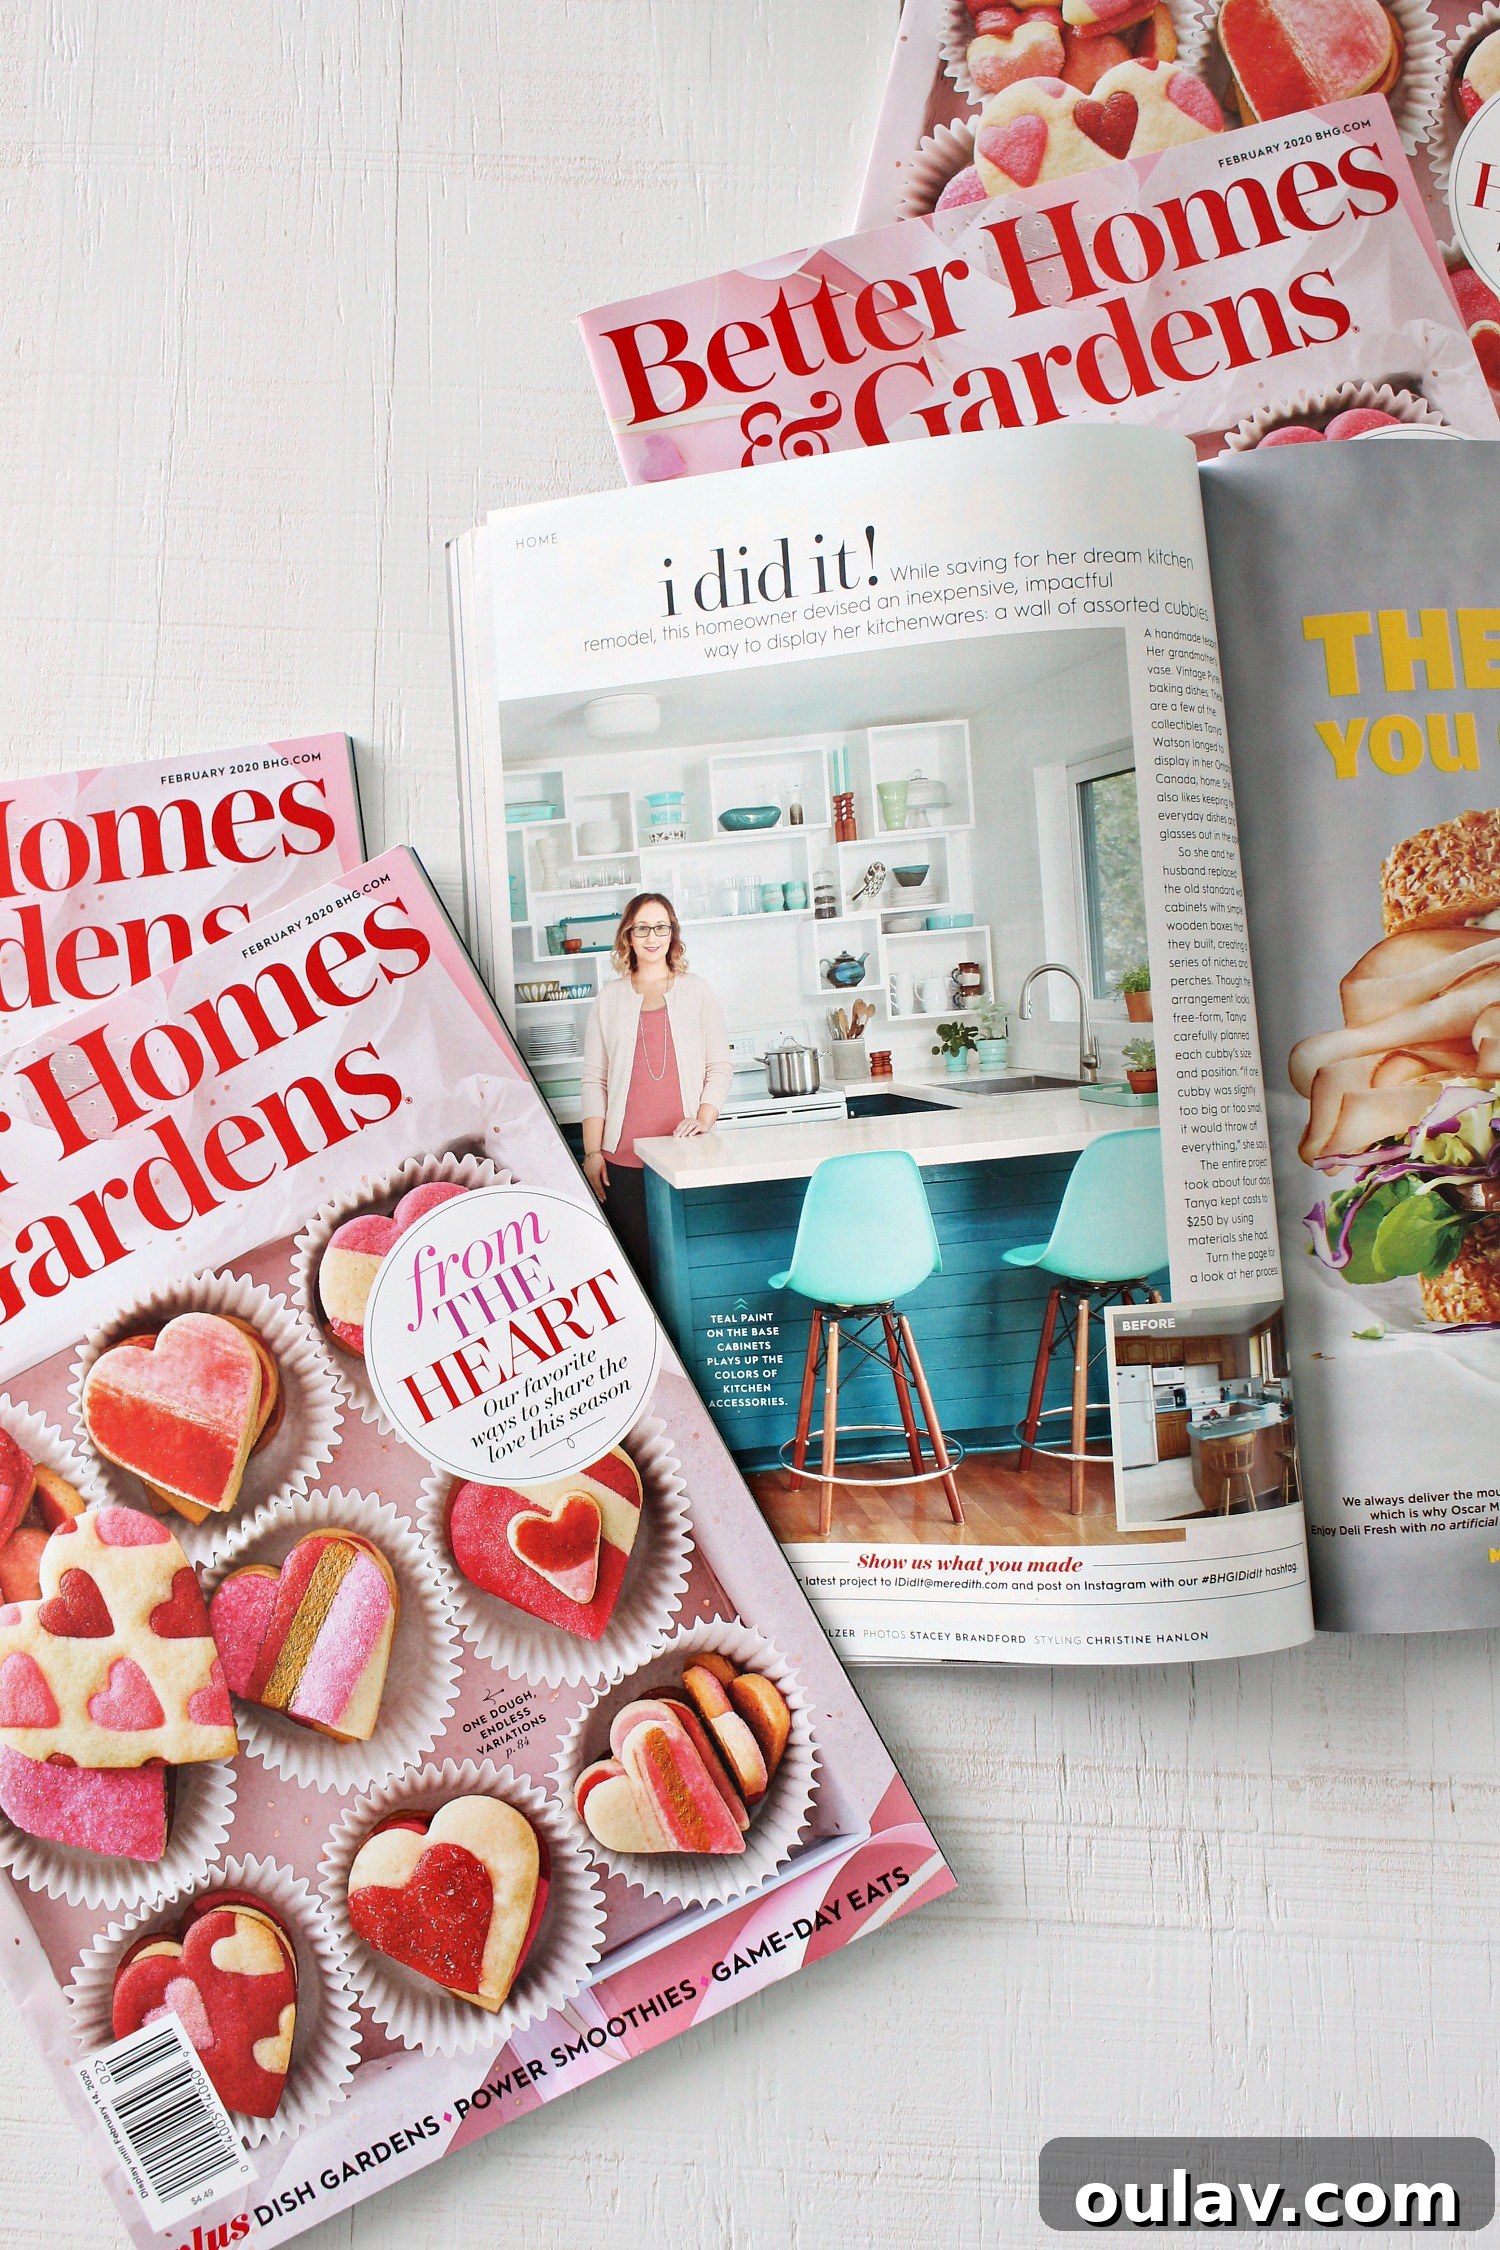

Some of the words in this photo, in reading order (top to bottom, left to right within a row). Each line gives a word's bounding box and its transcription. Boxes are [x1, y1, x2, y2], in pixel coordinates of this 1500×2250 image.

[1218, 143, 1281, 168] FEBRUARY
[1284, 134, 1313, 150] 2020
[1315, 119, 1371, 141] BHG.COM
[599, 258, 970, 427] Better
[979, 142, 1400, 321] Homes
[854, 267, 1352, 449] Gardens
[515, 532, 559, 550] HOME
[694, 537, 799, 612] did
[808, 525, 880, 595] it!
[890, 560, 940, 582] While
[946, 554, 1007, 577] saving
[1013, 550, 1040, 569] for
[1046, 548, 1077, 567] her
[1083, 546, 1142, 565] dream
[1147, 548, 1194, 571] kitchen
[583, 628, 657, 653] remodel,
[662, 624, 690, 642] this
[695, 607, 798, 637] homeowner
[803, 597, 871, 622] devised
[877, 594, 900, 609] an
[906, 580, 1019, 606] inexpensive,
[1025, 572, 1114, 594] impactful
[703, 642, 739, 660] way
[744, 637, 761, 654] to
[766, 628, 827, 650] display
[833, 624, 861, 640] her
[866, 607, 989, 636] kitchenwares:
[995, 607, 1007, 620] a
[1014, 599, 1051, 619] wall
[1057, 598, 1076, 616] of
[1083, 596, 1160, 614] assorted
[1302, 607, 1500, 697] THE
[1149, 682, 1183, 696] baking
[1151, 719, 1203, 732] collectibles
[160, 766, 226, 786] FEBRUARY
[229, 761, 260, 775] 2020
[263, 752, 322, 770] BHG.COM
[1158, 810, 1204, 823] everyday
[1162, 865, 1206, 876] husband
[241, 920, 302, 959] FEBRUARY
[304, 905, 335, 925] 2020
[335, 873, 391, 909] BHG.COM
[1164, 902, 1208, 913] cabinets
[1209, 902, 1226, 913] with
[1166, 920, 1208, 931] wooden
[1210, 920, 1233, 932] boxes
[1173, 1011, 1223, 1023] free-form,
[14, 897, 431, 1162] Homes
[1177, 1086, 1211, 1098] cubby
[1179, 1105, 1198, 1116] too
[1201, 1104, 1218, 1117] big
[1186, 1215, 1214, 1228] $250
[1216, 1214, 1229, 1227] by
[1231, 1213, 1254, 1226] using
[1206, 1252, 1229, 1263] Turn
[1231, 1250, 1246, 1261] the
[406, 1211, 550, 1332] from
[432, 1254, 555, 1343] THE
[710, 1314, 738, 1324] TEAL
[742, 1312, 774, 1323] PAINT
[1122, 1318, 1176, 1332] BEFORE
[706, 1329, 724, 1338] ON
[726, 1328, 748, 1337] THE
[751, 1326, 780, 1336] BASE
[397, 1268, 626, 1428] HEART
[717, 1341, 771, 1352] CABINETS
[707, 1356, 741, 1366] PLAYS
[744, 1355, 758, 1365] UP
[762, 1355, 784, 1364] THE
[483, 1390, 519, 1418] Our
[523, 1349, 597, 1398] favorite
[714, 1370, 760, 1380] COLORS
[762, 1369, 778, 1378] OF
[723, 1383, 771, 1394] KITCHEN
[470, 1414, 517, 1449] ways
[521, 1403, 540, 1422] to
[544, 1373, 595, 1410] share
[598, 1355, 629, 1380] the
[708, 1397, 788, 1408] ACCESSORIES.
[487, 1434, 526, 1463] love
[530, 1413, 565, 1441] this
[569, 1378, 632, 1421] season
[1342, 1496, 1361, 1507] We
[1364, 1495, 1405, 1506] always
[1408, 1492, 1450, 1504] deliver
[1453, 1490, 1473, 1500] the
[1370, 1509, 1405, 1520] which
[1409, 1508, 1419, 1518] is
[1422, 1506, 1447, 1518] why
[1451, 1504, 1486, 1515] Oscar
[1311, 1525, 1337, 1537] Enjoy
[1339, 1525, 1361, 1535] Deli
[1364, 1524, 1397, 1535] Fresh
[1400, 1522, 1427, 1534] with
[1430, 1523, 1446, 1532] no
[1449, 1517, 1498, 1530] artificial
[857, 1552, 908, 1570] Show
[911, 1560, 933, 1571] us
[934, 1554, 984, 1572] what
[984, 1560, 1023, 1576] you
[1027, 1556, 1083, 1573] made
[805, 1576, 836, 1586] latest
[839, 1576, 877, 1588] project
[880, 1577, 892, 1587] to
[1011, 1580, 1034, 1590] and
[1037, 1581, 1062, 1593] post
[1065, 1582, 1081, 1591] on
[1084, 1580, 1146, 1593] Instagram
[1149, 1577, 1175, 1589] with
[1178, 1577, 1198, 1587] our
[1201, 1567, 1263, 1585] #BHGIDidIt
[824, 1629, 856, 1638] LZER
[863, 1629, 906, 1640] PHOTOS
[909, 1631, 951, 1642] STACEY
[955, 1632, 1026, 1644] BRANDFORD
[1034, 1635, 1082, 1646] STYLING
[1086, 1635, 1152, 1646] CHRISTINE
[1156, 1631, 1209, 1644] HANLON
[462, 1714, 488, 1733] ONE
[489, 1690, 537, 1719] DOUGH,
[476, 1713, 547, 1755] VARIATIONS
[480, 1707, 531, 1740] ENDLESS
[517, 1736, 530, 1750] 84
[175, 2213, 250, 2250] lus
[253, 2181, 317, 2228] DISH
[319, 2114, 441, 2190] GARDENS
[454, 2059, 548, 2121] POWER
[550, 1978, 697, 2068] SMOOTHIES
[711, 1904, 844, 1982] GAME-DAY
[848, 1866, 911, 1913] EATS
[80, 2069, 95, 2091] 2020
[190, 2069, 216, 2109] 14060
[92, 2090, 101, 2105] 14,
[99, 2106, 121, 2145] February
[212, 2112, 237, 2151] 14005
[118, 2145, 132, 2165] until
[129, 2166, 149, 2199] Display
[190, 2188, 214, 2205] $4.49
